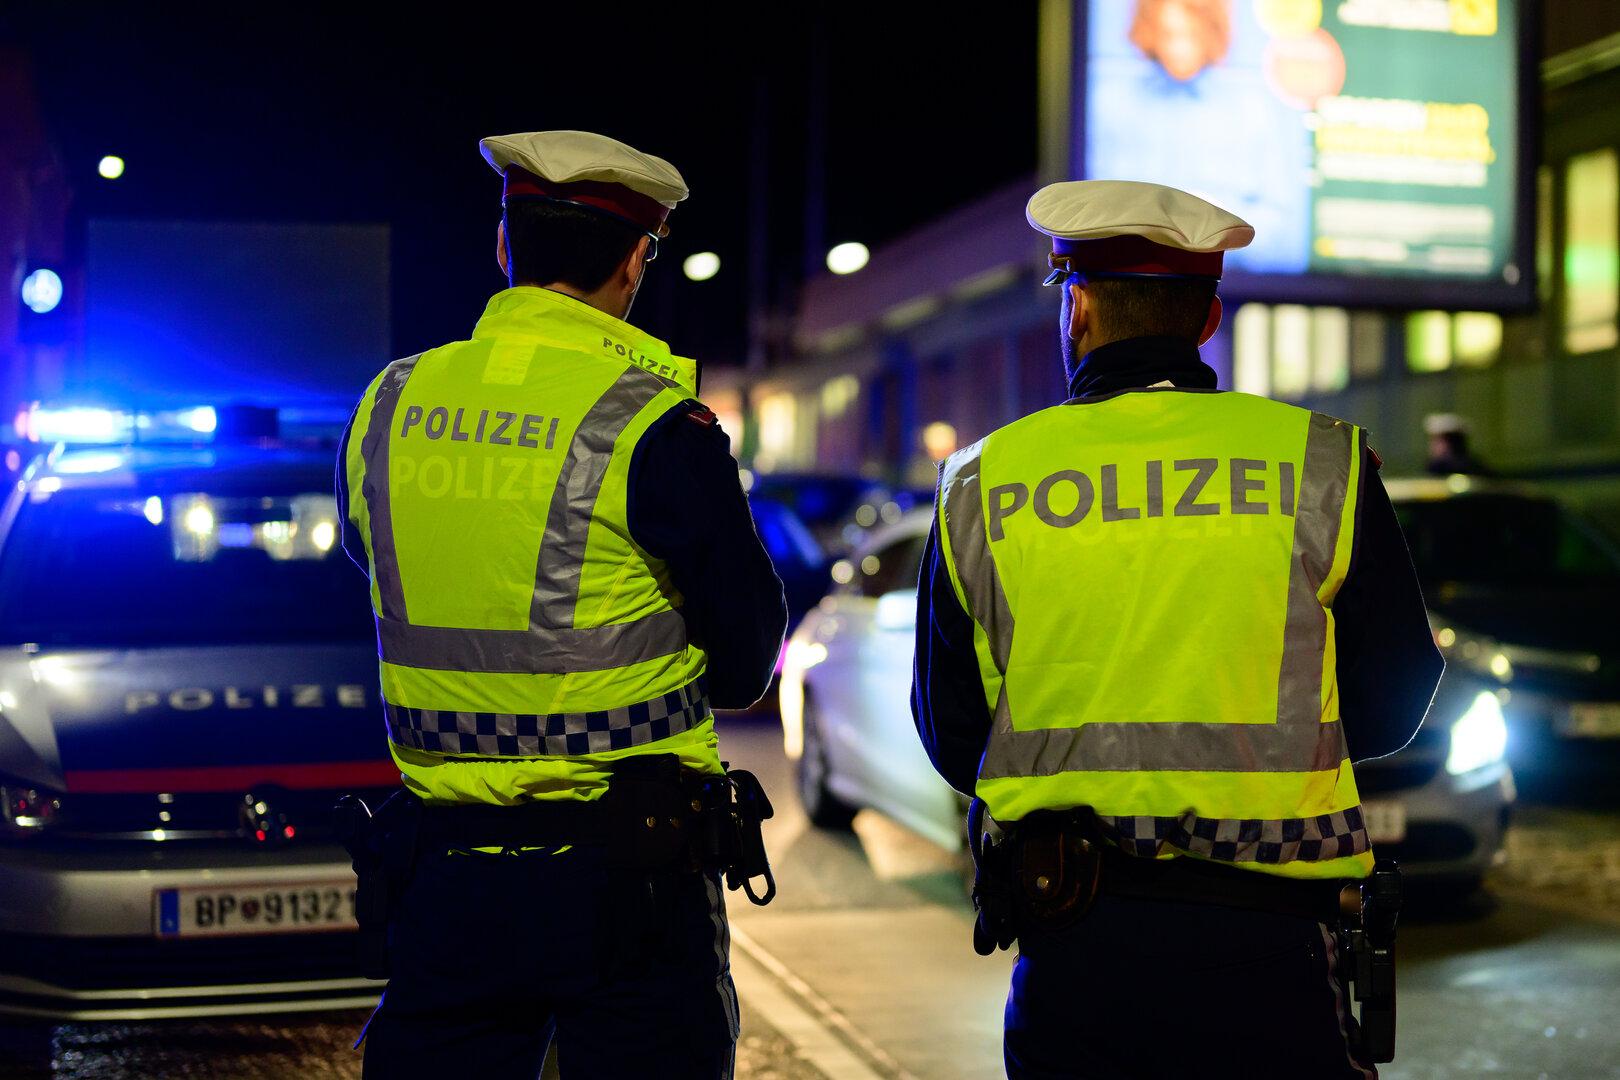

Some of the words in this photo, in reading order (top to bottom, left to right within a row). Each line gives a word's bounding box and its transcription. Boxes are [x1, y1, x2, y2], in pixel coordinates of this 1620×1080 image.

[603, 337, 678, 380] POLIZEI
[400, 405, 560, 449] POLIZEI
[392, 455, 560, 500] POLIZE
[988, 457, 1295, 543] POLIZEI
[125, 684, 365, 713] POLIZE
[195, 893, 236, 927] BP
